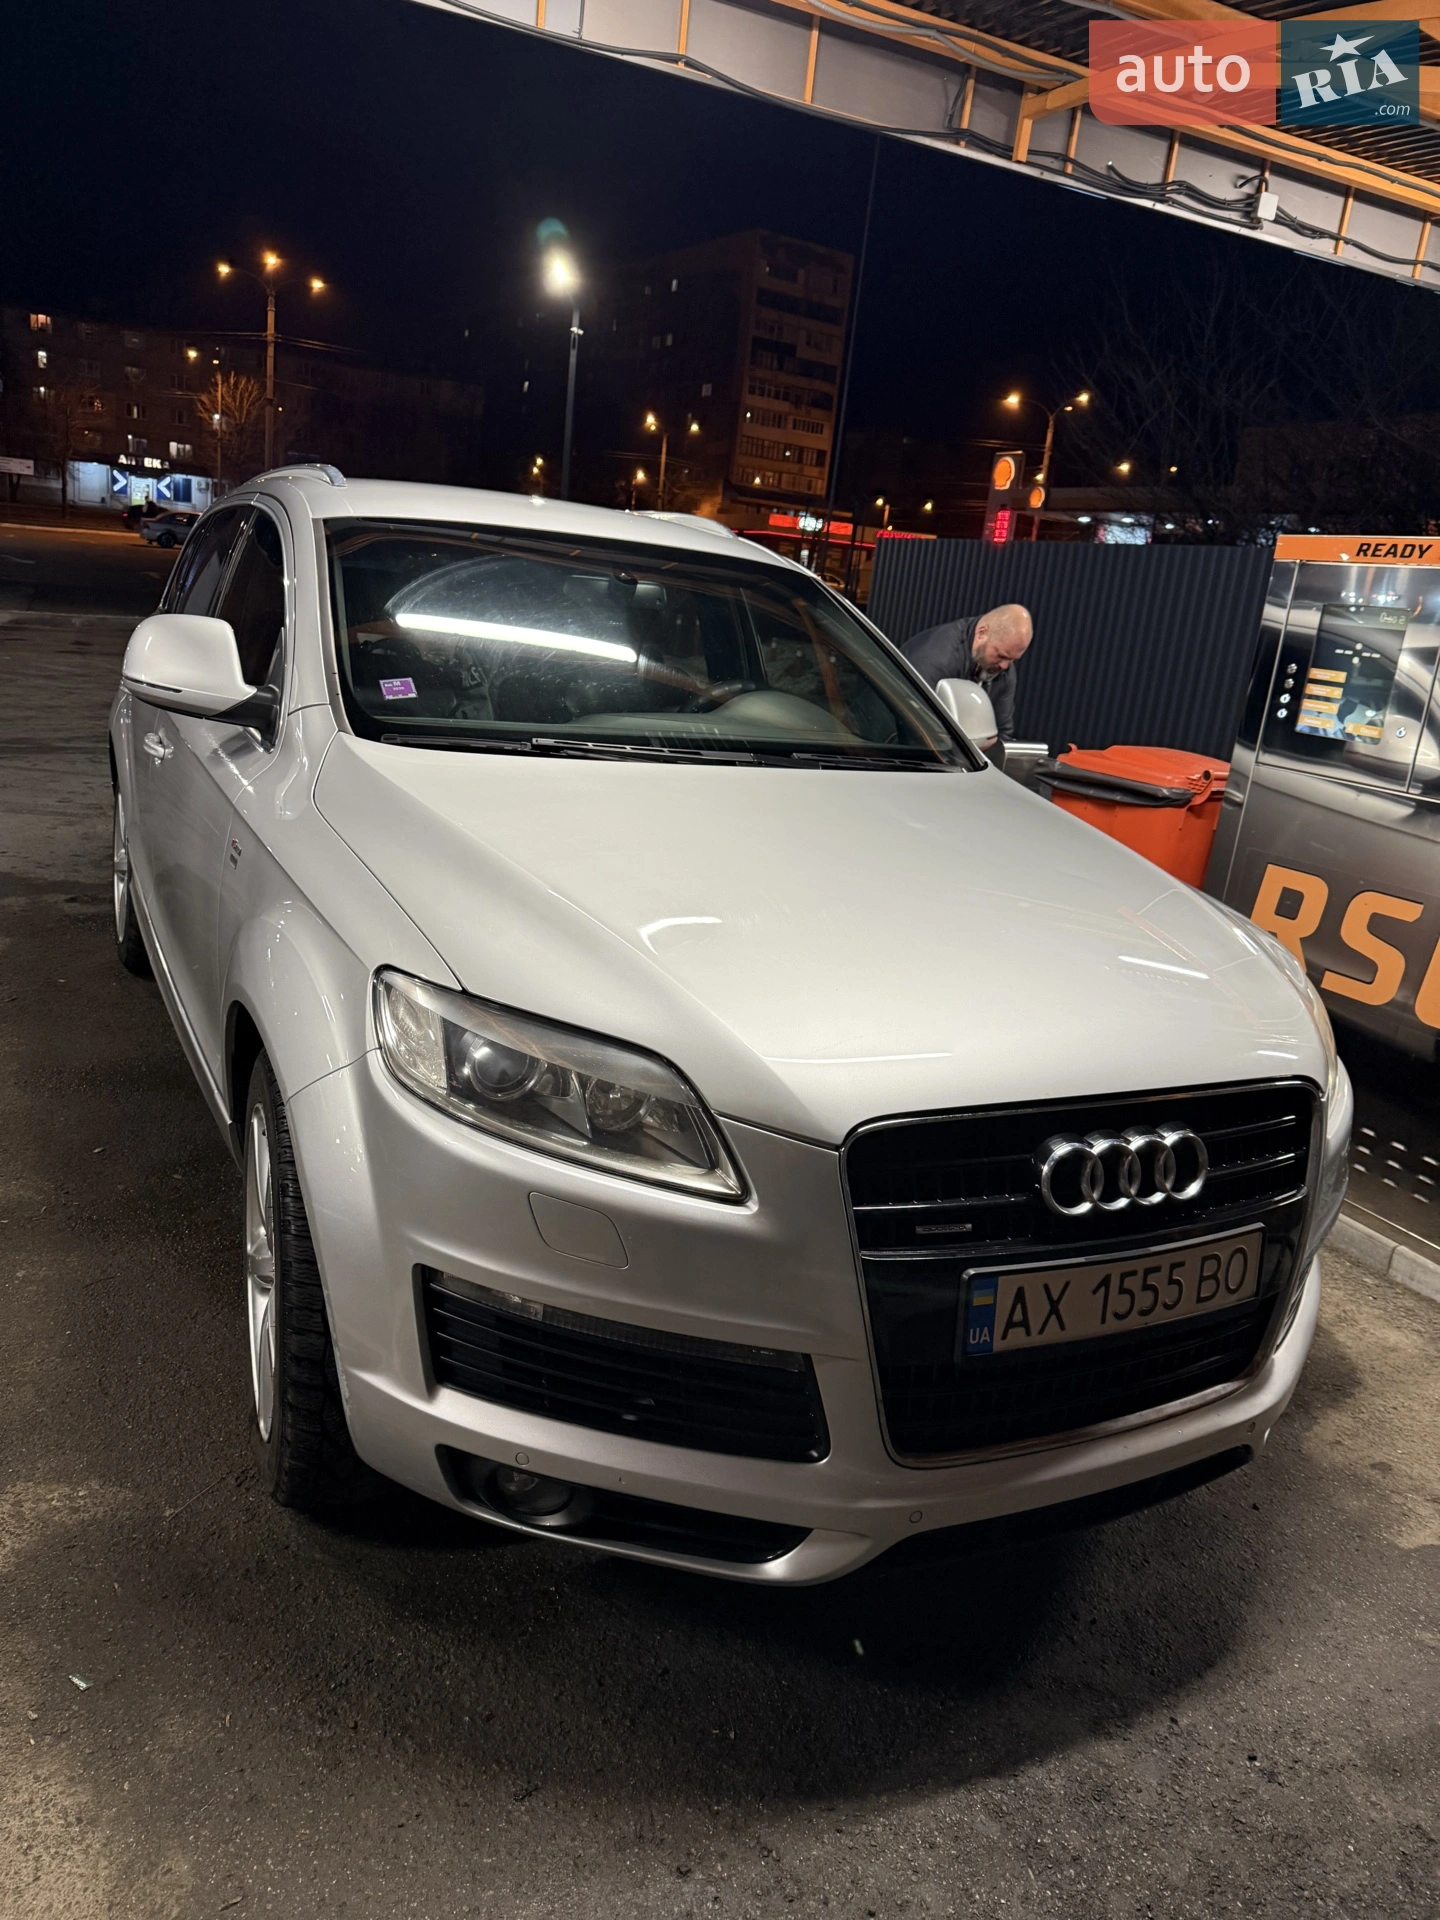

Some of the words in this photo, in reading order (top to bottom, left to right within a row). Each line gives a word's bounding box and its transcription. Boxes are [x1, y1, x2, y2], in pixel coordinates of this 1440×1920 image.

[1355, 543, 1434, 559] READY
[1250, 863, 1440, 1030] RS
[1001, 1280, 1071, 1341] AX
[1091, 1260, 1187, 1325] 1555
[1195, 1246, 1249, 1305] BO
[969, 1328, 991, 1345] UA
